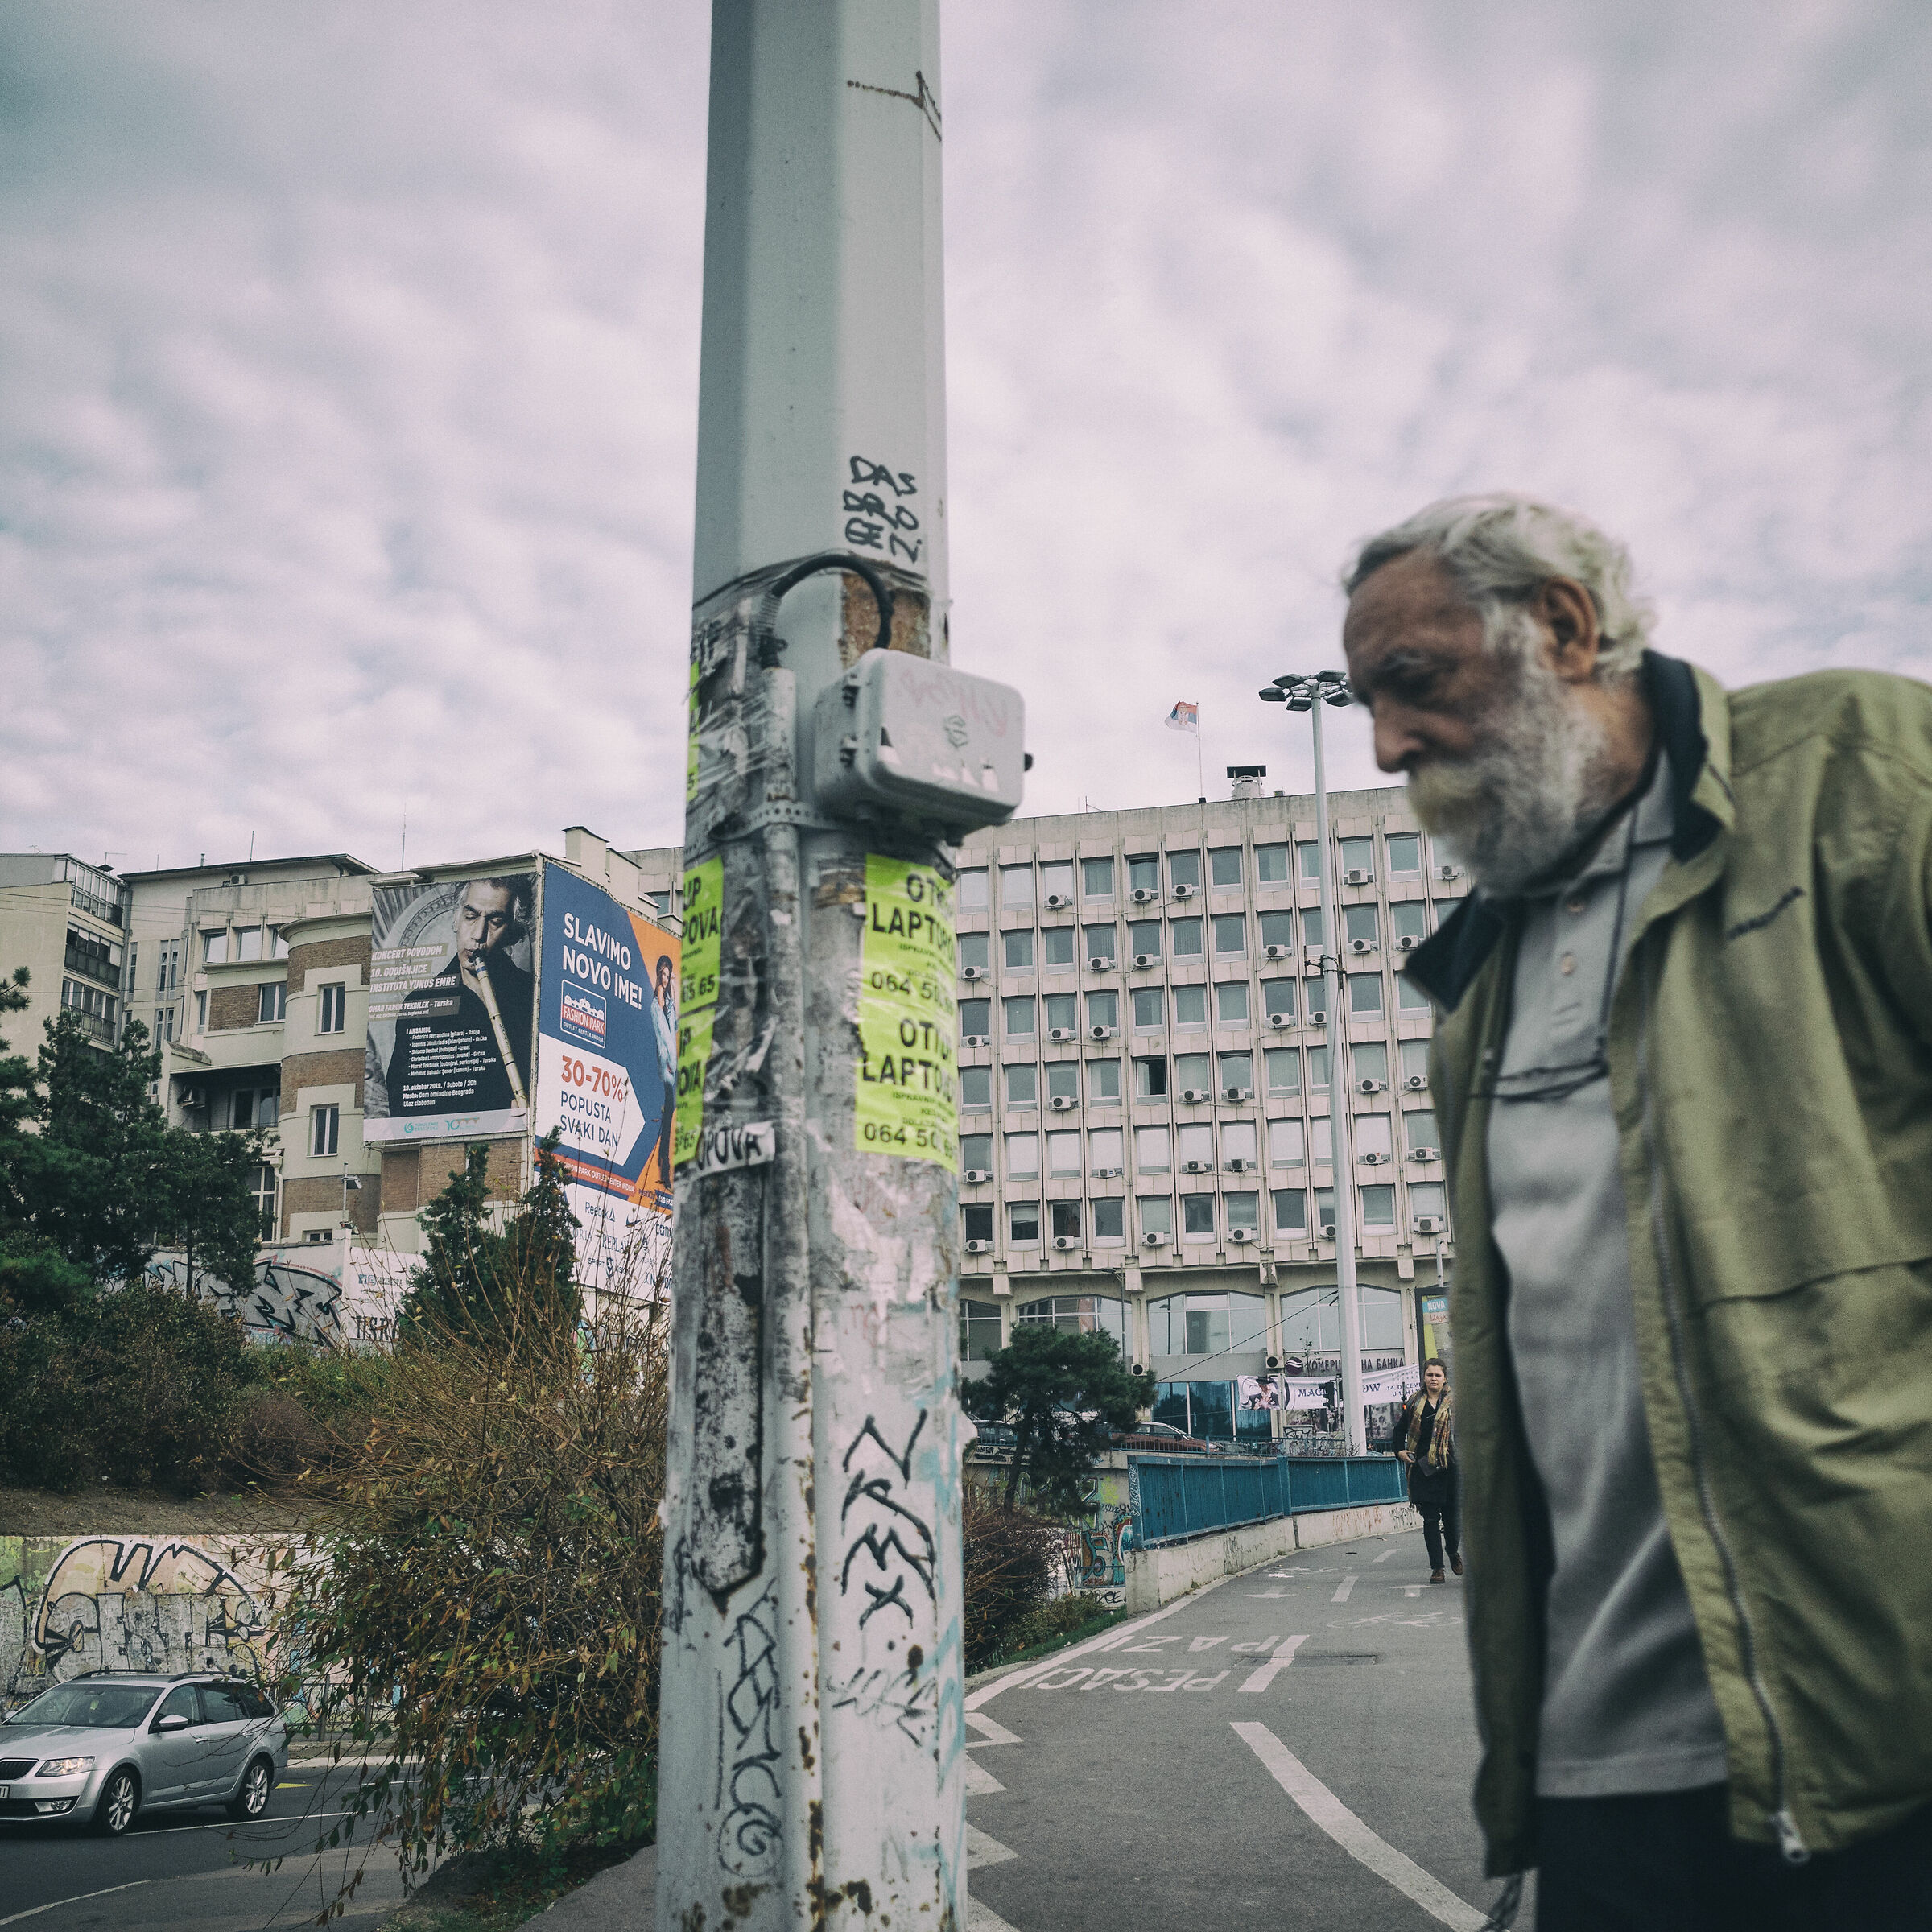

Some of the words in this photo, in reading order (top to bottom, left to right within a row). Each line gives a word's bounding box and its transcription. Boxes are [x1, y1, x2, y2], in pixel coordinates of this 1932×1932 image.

[564, 912, 631, 971] SLAVIMO
[372, 948, 406, 960] KONCERT
[407, 946, 443, 957] POVODOM
[370, 968, 382, 978] 10.
[383, 963, 428, 976] GODIŠNJICE
[563, 945, 611, 991] NOVO
[614, 972, 642, 1010] IME!
[370, 980, 407, 993] INSTITUTA
[409, 978, 435, 989] YUNUS
[435, 976, 456, 987] EMRE
[872, 971, 911, 996] 064
[369, 1004, 384, 1013] OMAR
[384, 1003, 403, 1011] FARUK
[403, 1001, 429, 1010] TEKBILEK
[434, 999, 453, 1008] Turska
[564, 1005, 588, 1027] FASHION
[589, 1017, 605, 1034] PARK
[409, 1026, 431, 1034] ANSAMBL
[564, 1022, 578, 1032] OUTLET
[578, 1028, 592, 1038] CENTER
[561, 1055, 623, 1102] 30-70%
[561, 1090, 611, 1124] POPUSTA
[560, 1114, 594, 1141] SVAKI
[598, 1126, 618, 1147] DAN
[865, 1122, 907, 1146] 064
[578, 1166, 591, 1178] PARK
[1427, 1300, 1446, 1311] NOVA
[1377, 1357, 1405, 1369] БАНКА
